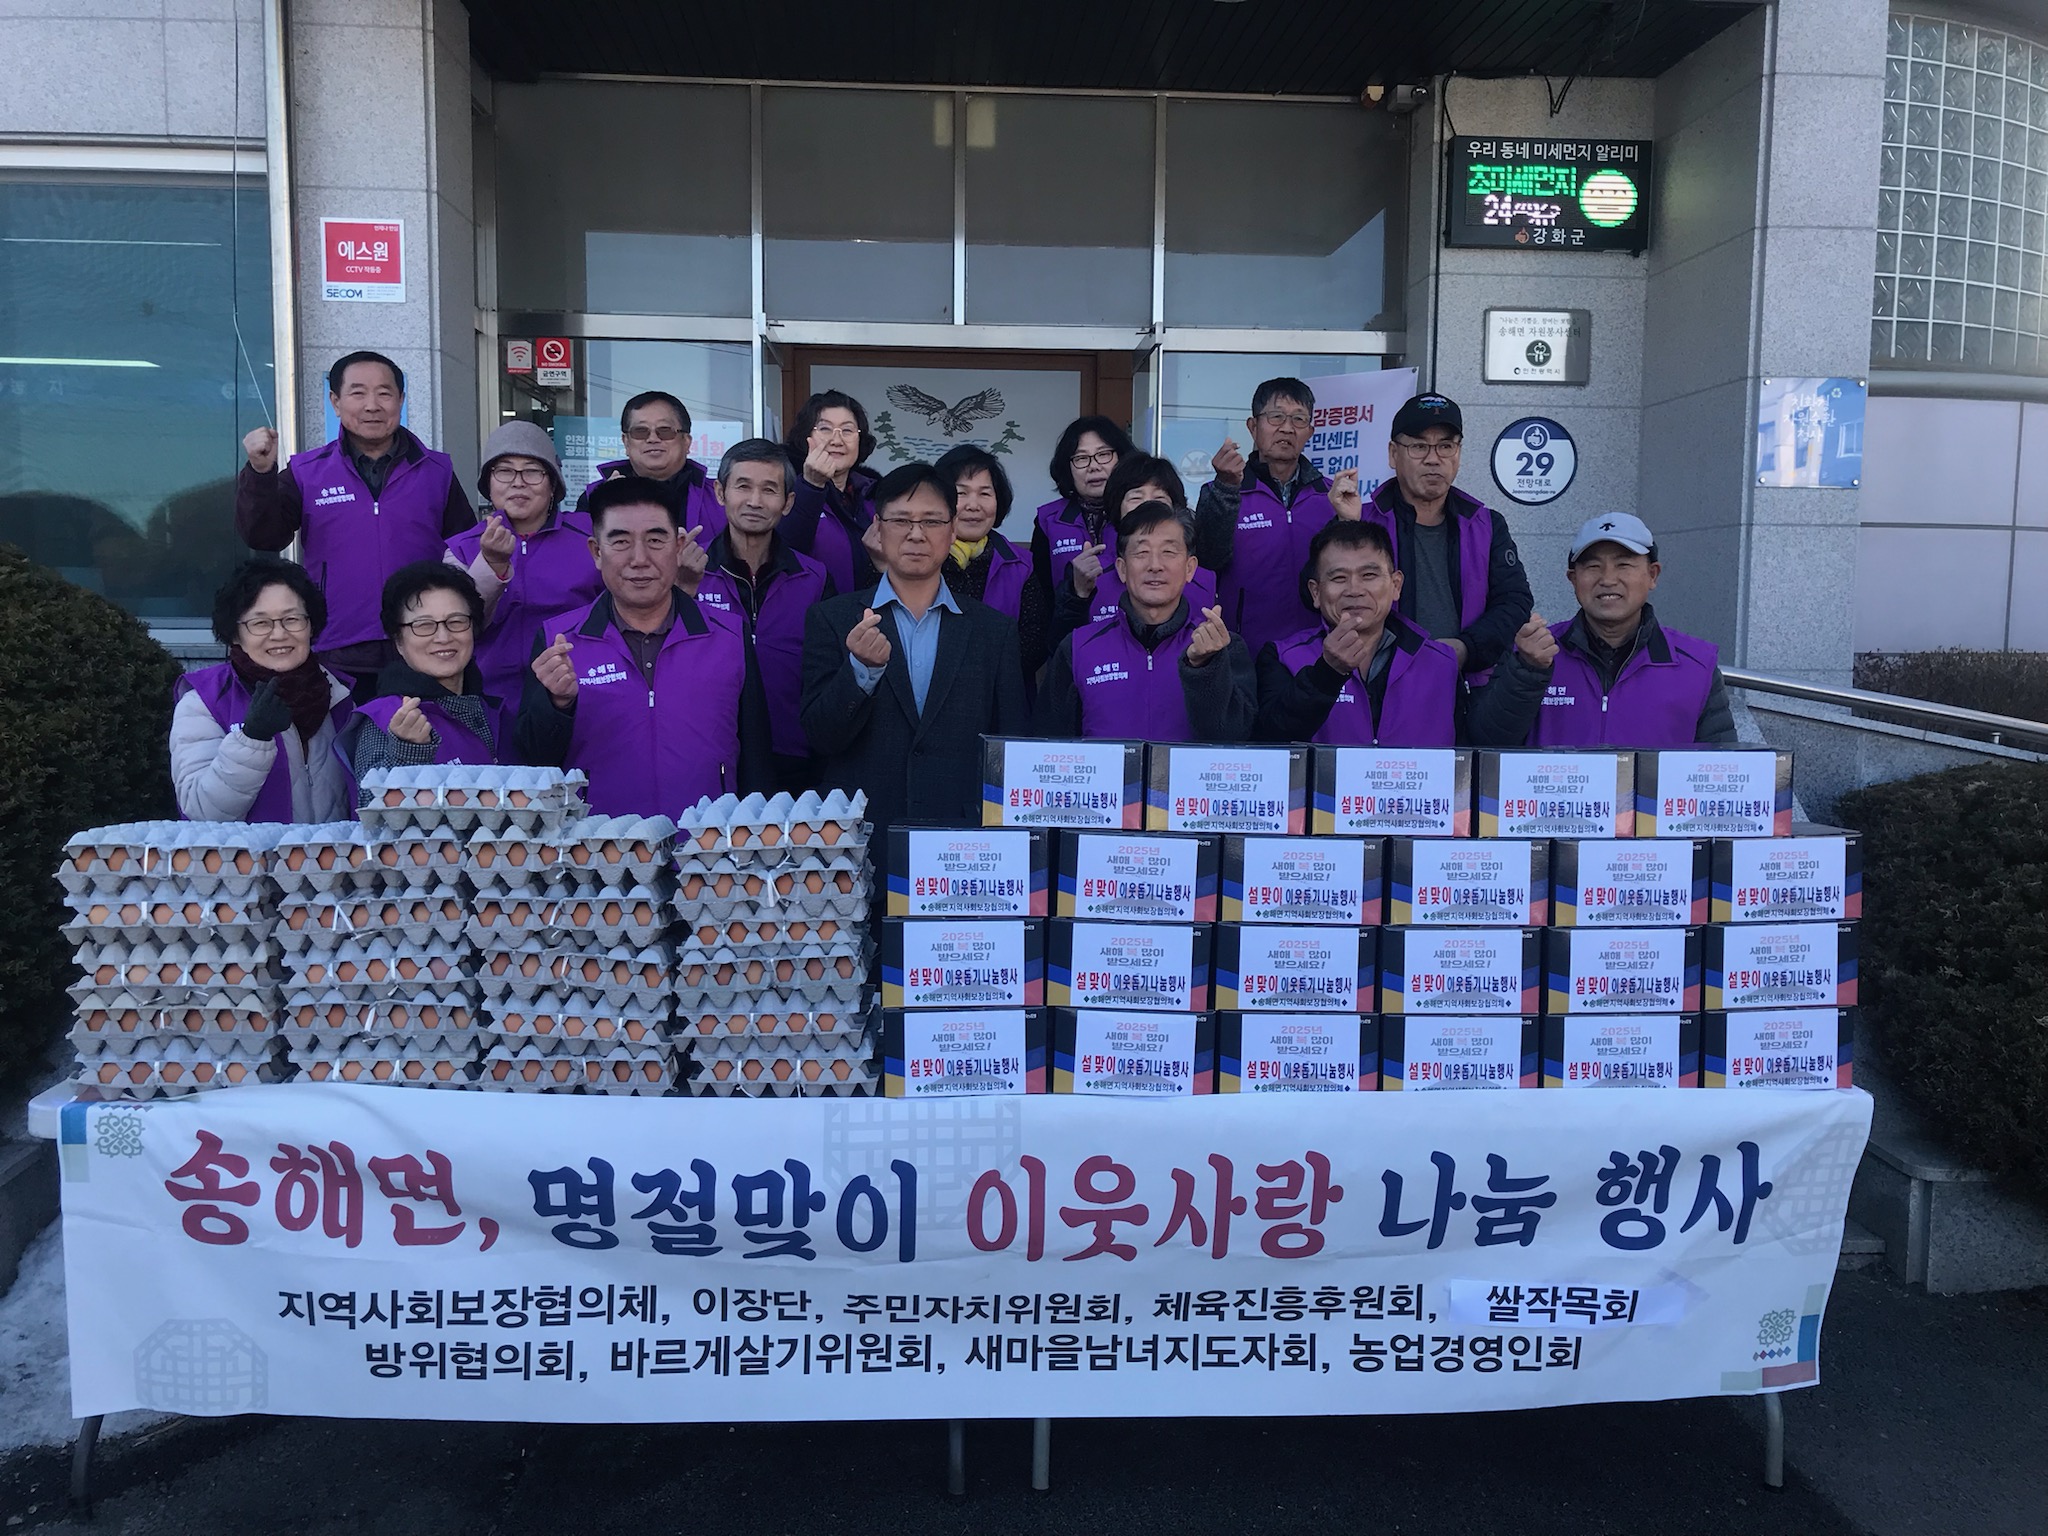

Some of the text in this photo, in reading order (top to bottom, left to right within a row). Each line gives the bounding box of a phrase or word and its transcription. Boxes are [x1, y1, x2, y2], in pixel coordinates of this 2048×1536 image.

[1467, 142, 1639, 162] 우리 동네 미세먼지 알리미
[337, 241, 389, 262] 에스원
[345, 265, 363, 273] CCTV
[326, 288, 363, 298] SECOM
[1499, 326, 1581, 338] 송해면 자원봉사센터
[565, 434, 595, 446] 인천시
[1515, 452, 1554, 477] 29
[1517, 479, 1552, 488] 전망대로
[588, 663, 616, 677] 송해면
[1543, 686, 1566, 696] 해면
[1044, 754, 1086, 763] 2025년
[1074, 765, 1096, 774] 많이
[1209, 763, 1252, 771] 2025년
[1375, 761, 1417, 769] 2025년
[1538, 765, 1579, 773] 2025년
[1698, 764, 1739, 772] 2025년
[949, 843, 990, 851] 2025년
[1118, 845, 1160, 855] 2025년
[979, 853, 1001, 861] 많이
[1283, 852, 1325, 861] 2025년
[1451, 852, 1492, 860] 2025년
[1617, 853, 1658, 861] 2025년
[1769, 851, 1809, 861] 2025년
[1481, 862, 1503, 870] 많이
[942, 932, 984, 941] 2025년
[1760, 935, 1800, 944] 2025년
[1111, 938, 1153, 946] 2025년
[1278, 941, 1320, 949] 2025년
[1445, 940, 1486, 948] 2025년
[1609, 941, 1649, 950] 2025년
[943, 1022, 985, 1031] 2025년
[1117, 1022, 1159, 1032] 2025년
[1281, 1026, 1323, 1034] 2025년
[1764, 1021, 1803, 1031] 2025년
[1442, 1027, 1483, 1036] 2025년
[1601, 1027, 1642, 1035] 2025년
[165, 1129, 1773, 1263] 송해면, 명절맞이 이웃사랑 나눔 행사
[278, 1283, 1639, 1329] 지역사회보장협의체, 이장단, 주민자치위원회, 체육진흥후원회, 쌀작목회
[364, 1332, 1582, 1382] 방위협의회, 바르게살기위원회, 새마을남녀지도자회, 농업경영인회
